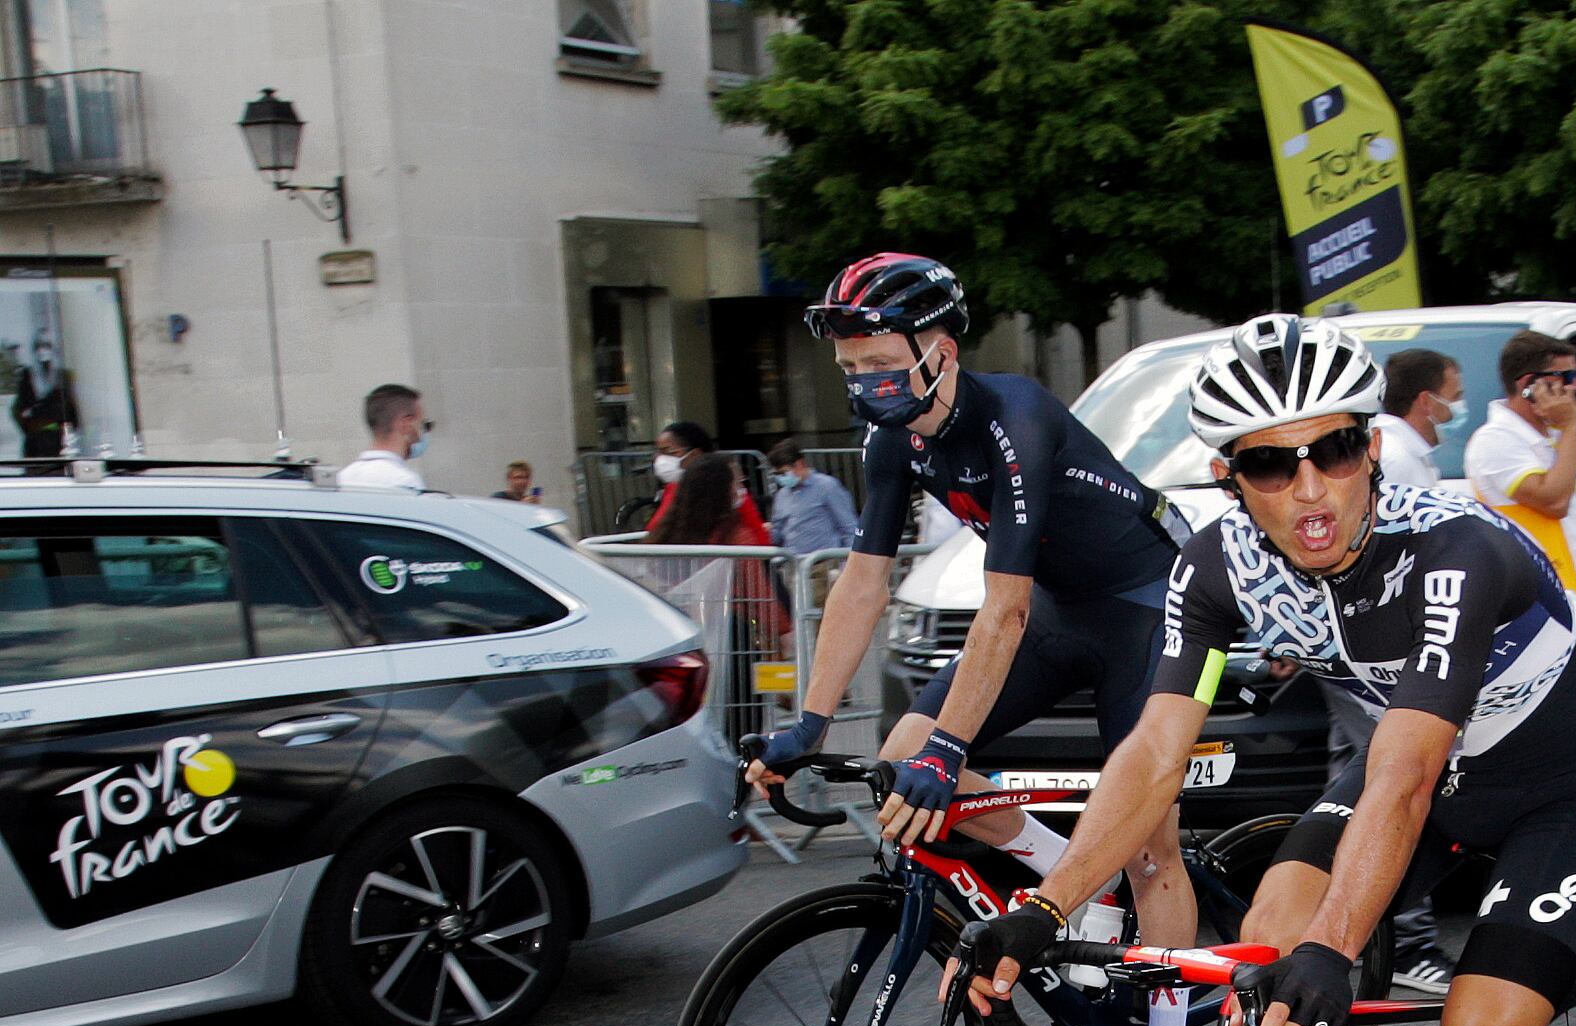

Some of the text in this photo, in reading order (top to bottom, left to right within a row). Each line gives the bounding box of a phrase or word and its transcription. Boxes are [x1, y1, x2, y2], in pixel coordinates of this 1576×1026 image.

[1311, 94, 1334, 124] P
[1307, 216, 1377, 264] ACCUEIL
[1309, 241, 1372, 287] PUBLIC
[989, 420, 1028, 526] GRENADIER
[1065, 467, 1138, 503] GRENADIER
[1162, 554, 1196, 659] BMC
[1416, 569, 1467, 681] BMC
[486, 647, 617, 671] Organisation
[166, 789, 195, 817] de
[960, 793, 1031, 812] PINARELLO
[1312, 802, 1353, 820] BM
